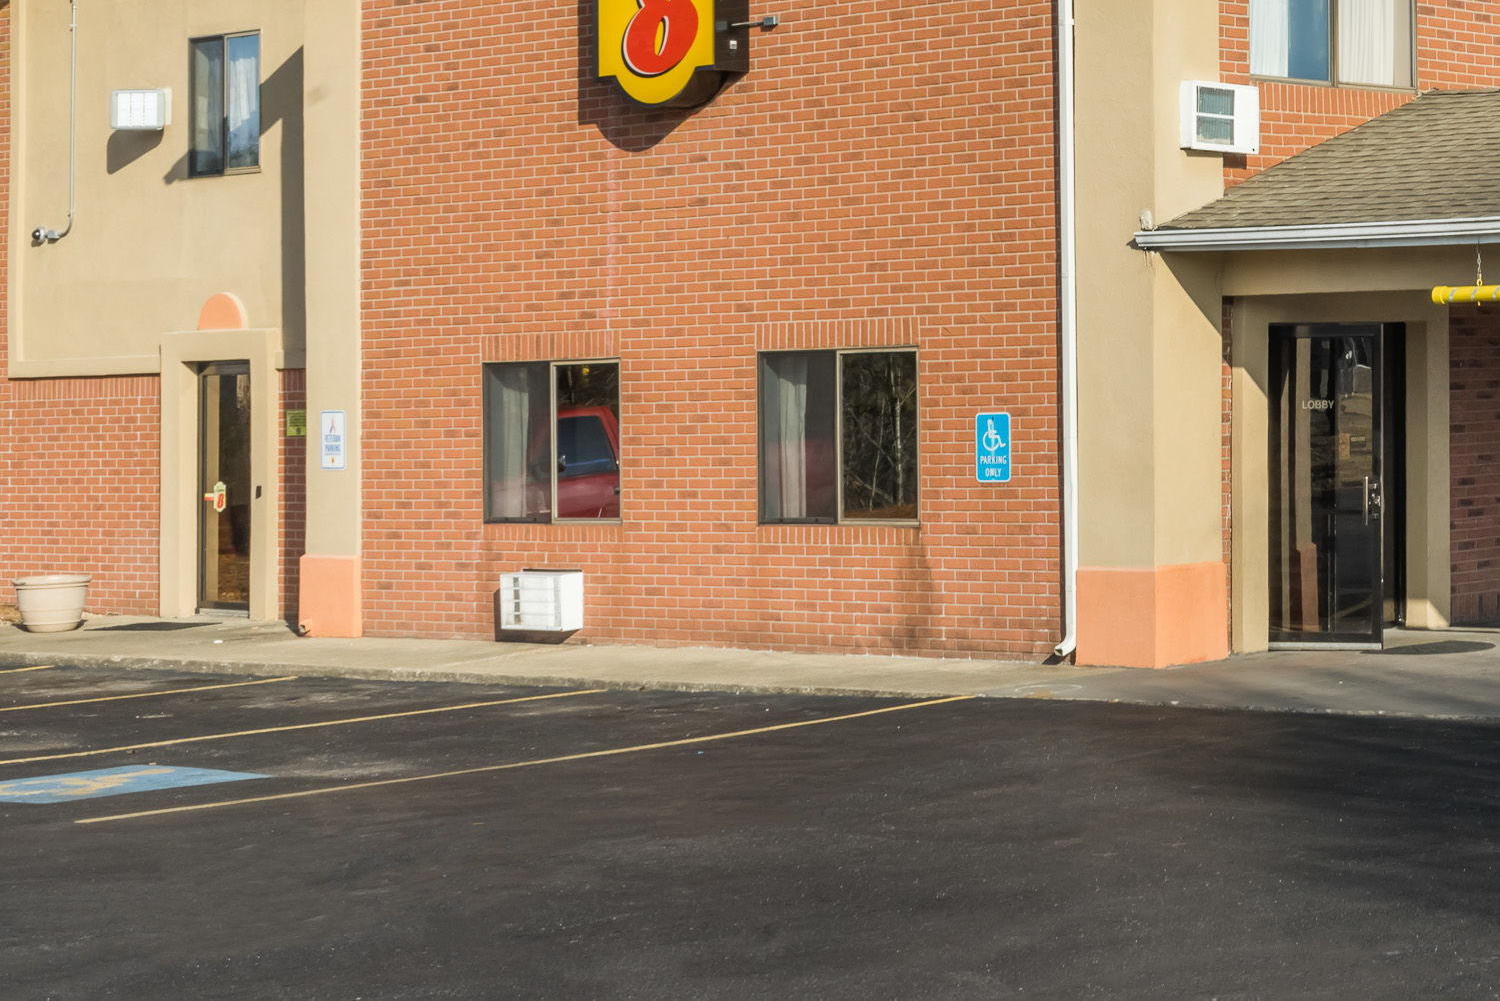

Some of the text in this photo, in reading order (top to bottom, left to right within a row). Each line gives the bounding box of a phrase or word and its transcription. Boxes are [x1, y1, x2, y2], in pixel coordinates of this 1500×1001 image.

[1301, 400, 1335, 410] LOBBY
[980, 455, 1007, 465] PARKING
[985, 467, 1002, 478] ONLY
[216, 492, 225, 509] 8
